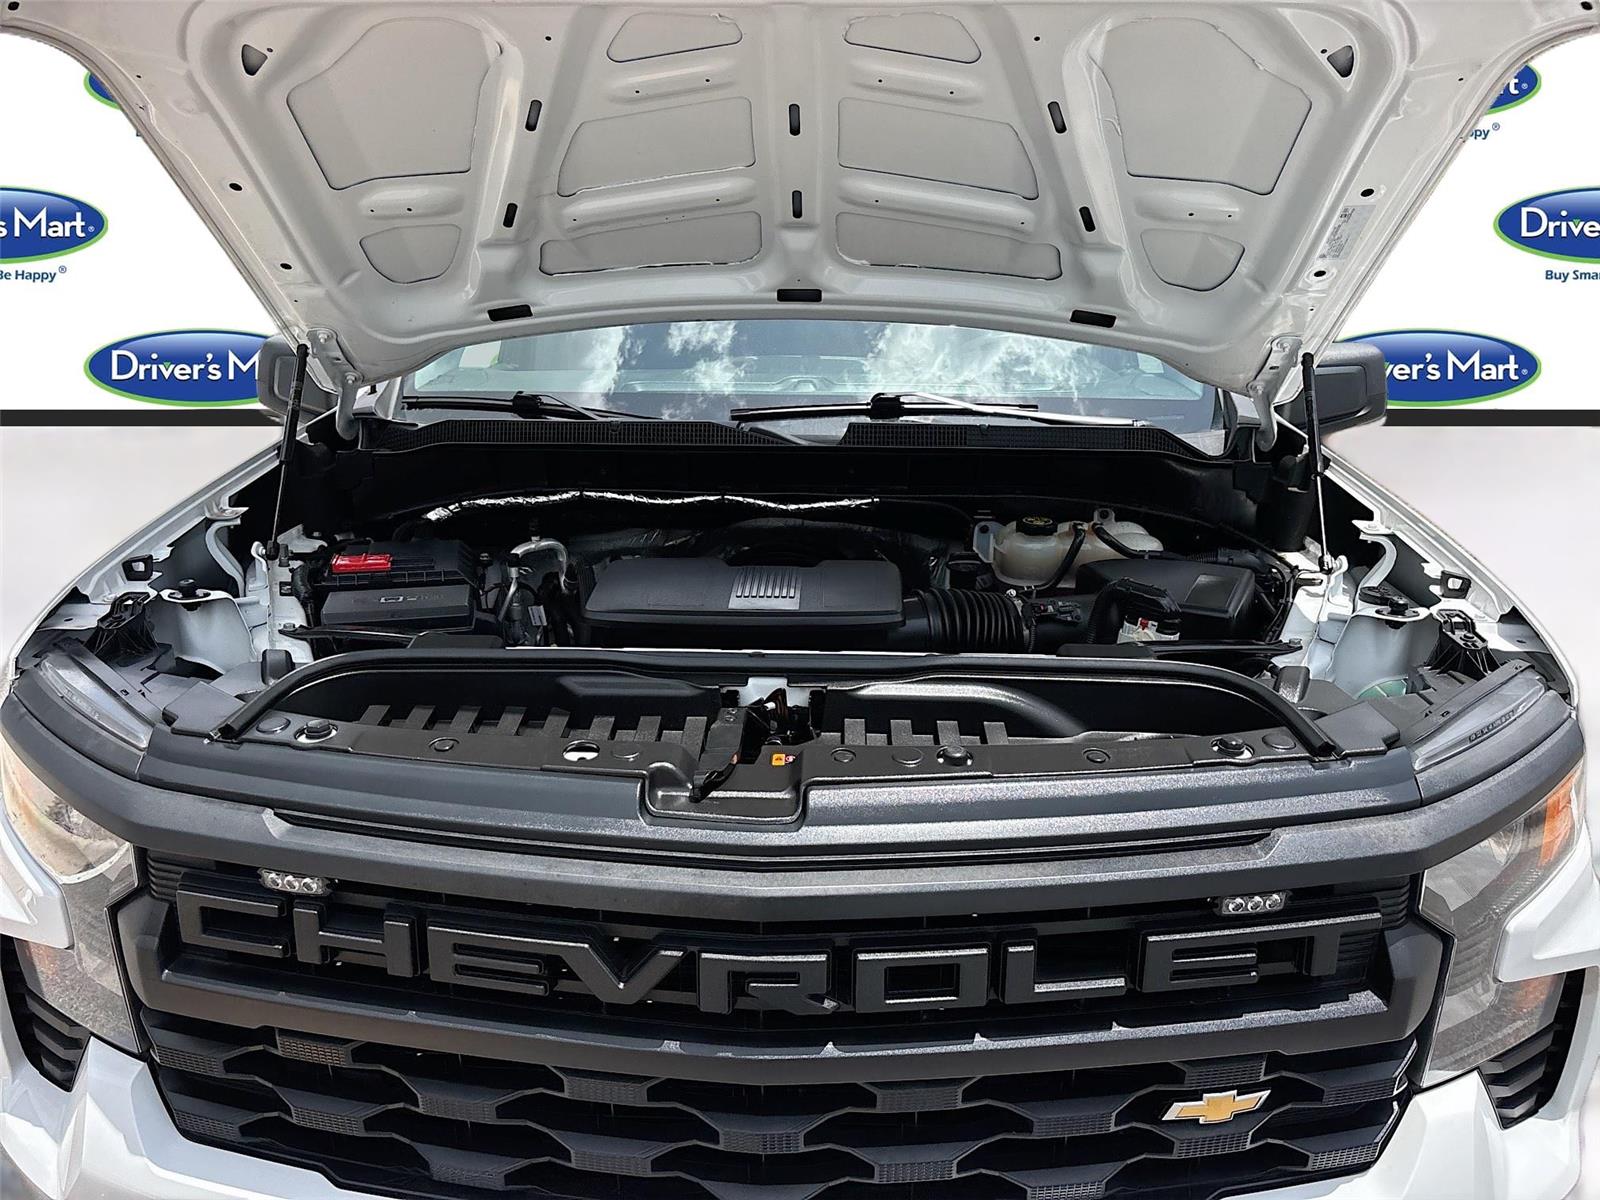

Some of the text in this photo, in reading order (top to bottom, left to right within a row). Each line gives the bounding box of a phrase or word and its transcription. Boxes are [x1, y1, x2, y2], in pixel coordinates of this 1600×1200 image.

[14, 206, 86, 237] Mart
[15, 270, 57, 283] Happy
[1545, 269, 1570, 283] Buy
[111, 349, 222, 381] Driver's
[1447, 349, 1519, 381] Mart
[175, 880, 1384, 1016] CHEVROLET
